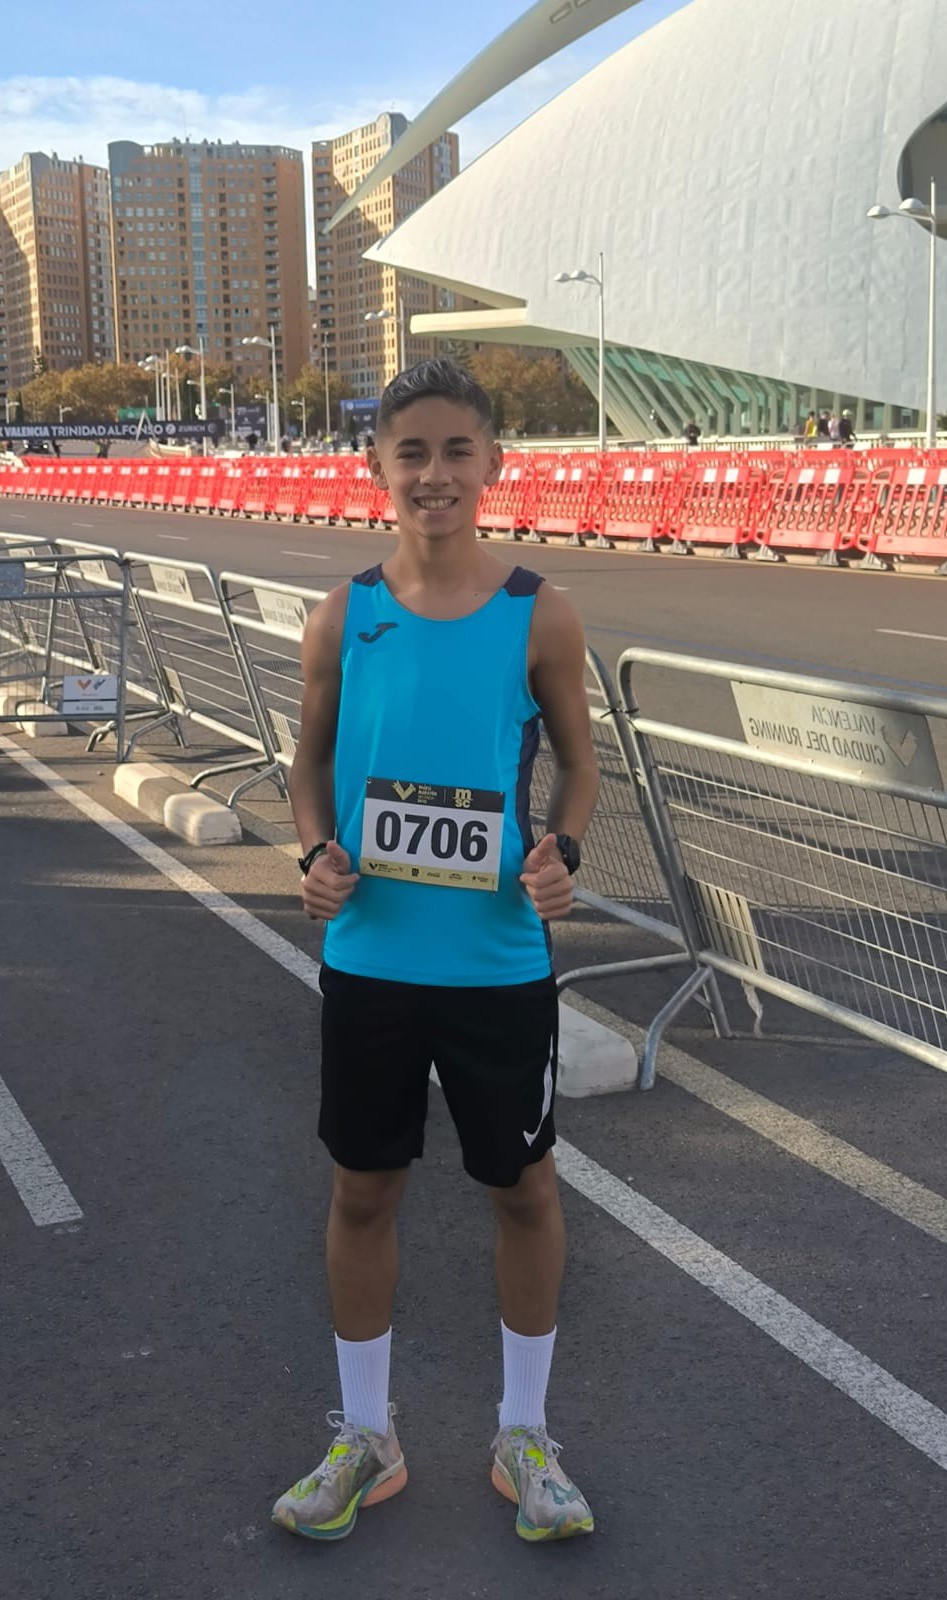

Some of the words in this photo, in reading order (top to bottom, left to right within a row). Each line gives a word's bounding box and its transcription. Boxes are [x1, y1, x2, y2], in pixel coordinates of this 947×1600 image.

[4, 425, 50, 437] VALENCIA
[51, 425, 105, 437] TRINIDAD
[106, 423, 164, 436] ALFONSO
[178, 425, 206, 433] ZURICH
[375, 810, 488, 862] 0706
